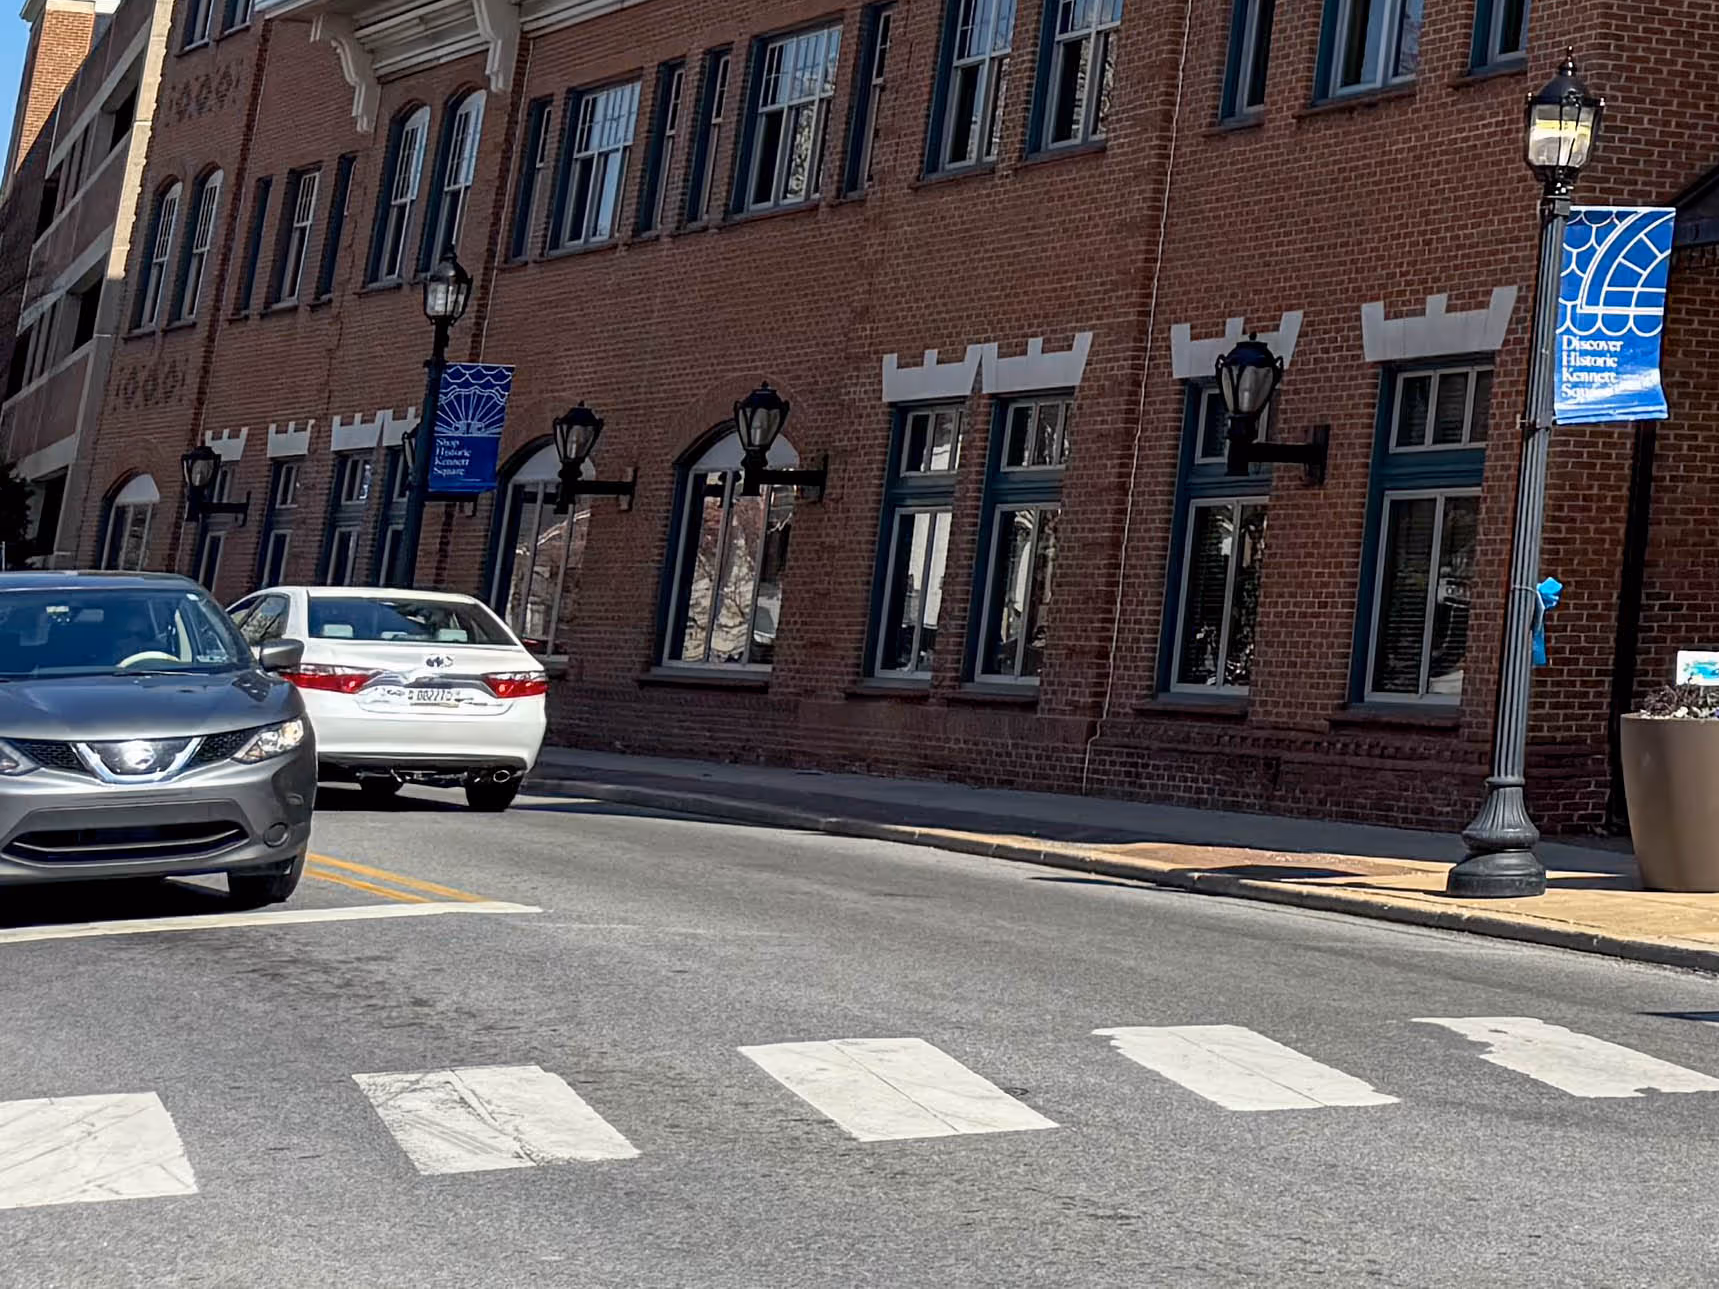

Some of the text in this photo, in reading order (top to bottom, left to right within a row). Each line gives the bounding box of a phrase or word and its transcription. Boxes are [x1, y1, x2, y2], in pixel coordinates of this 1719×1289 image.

[1562, 335, 1623, 351] Discover
[1562, 351, 1618, 367] Historic
[1562, 367, 1617, 382] Kennett
[436, 437, 460, 448] Shop
[435, 456, 470, 466] Kennett
[433, 467, 465, 477] Square
